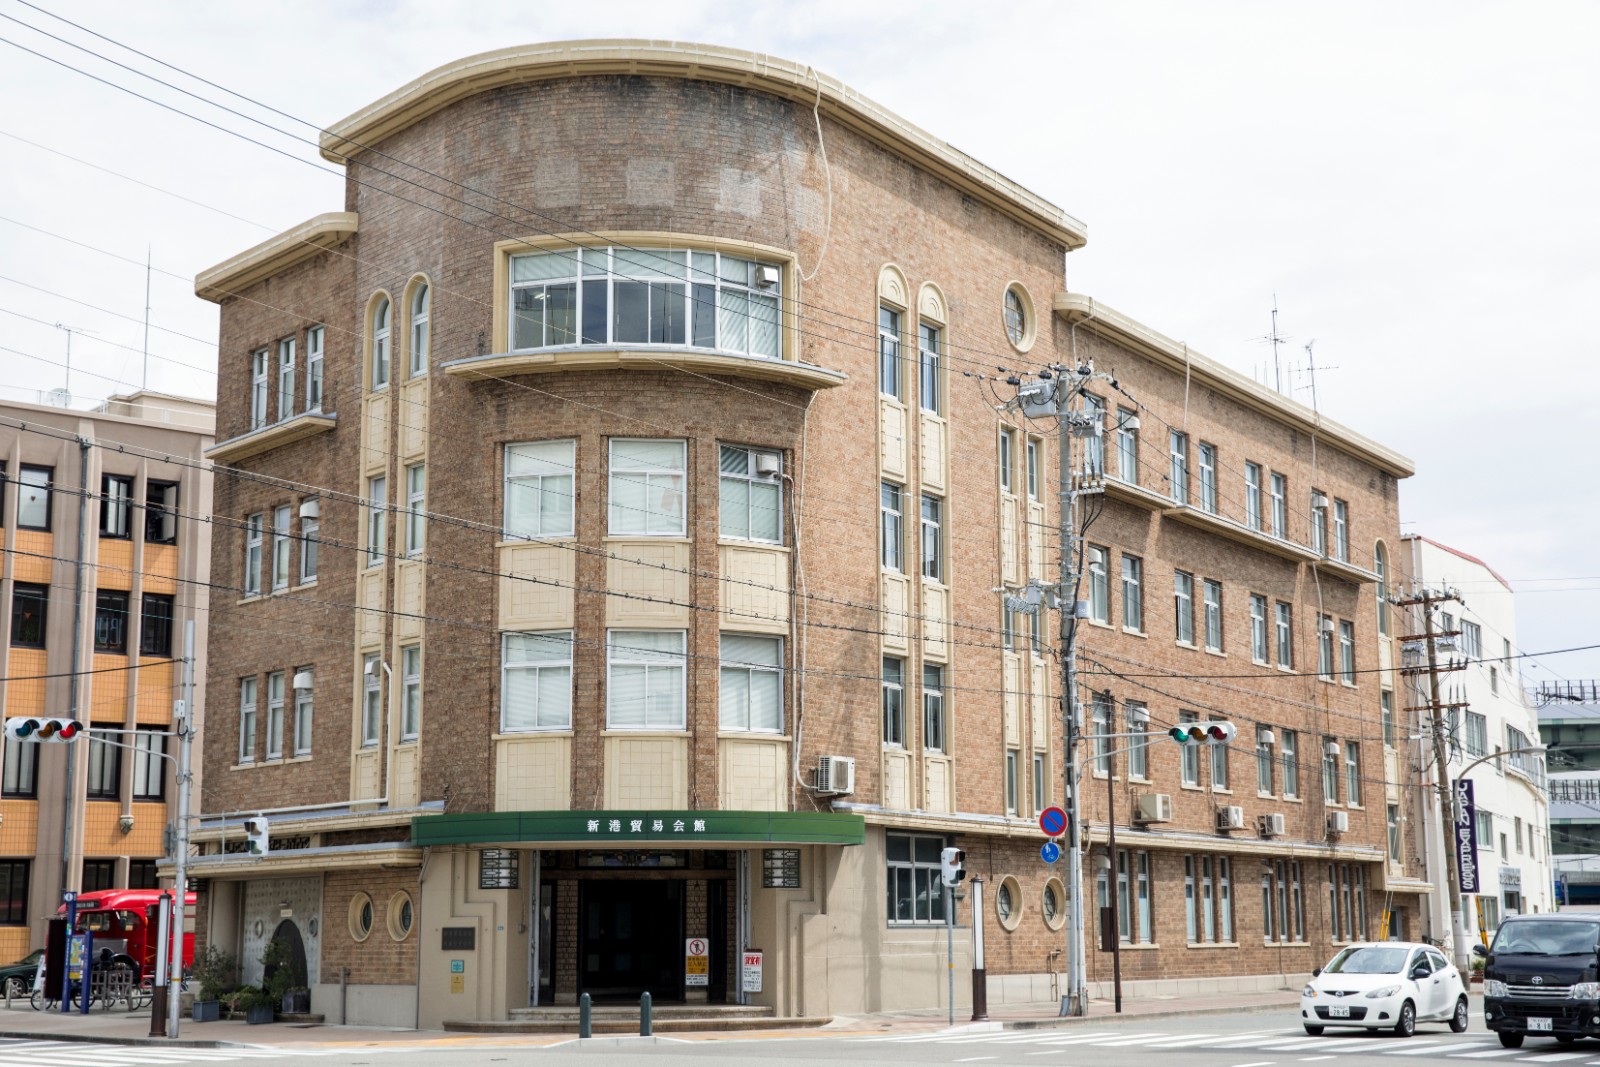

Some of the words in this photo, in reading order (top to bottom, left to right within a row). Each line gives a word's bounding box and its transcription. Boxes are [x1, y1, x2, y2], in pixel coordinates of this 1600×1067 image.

[587, 819, 706, 832] 新港貿易会館
[1458, 782, 1470, 826] JAPAN
[1459, 829, 1474, 889] EXPRESS
